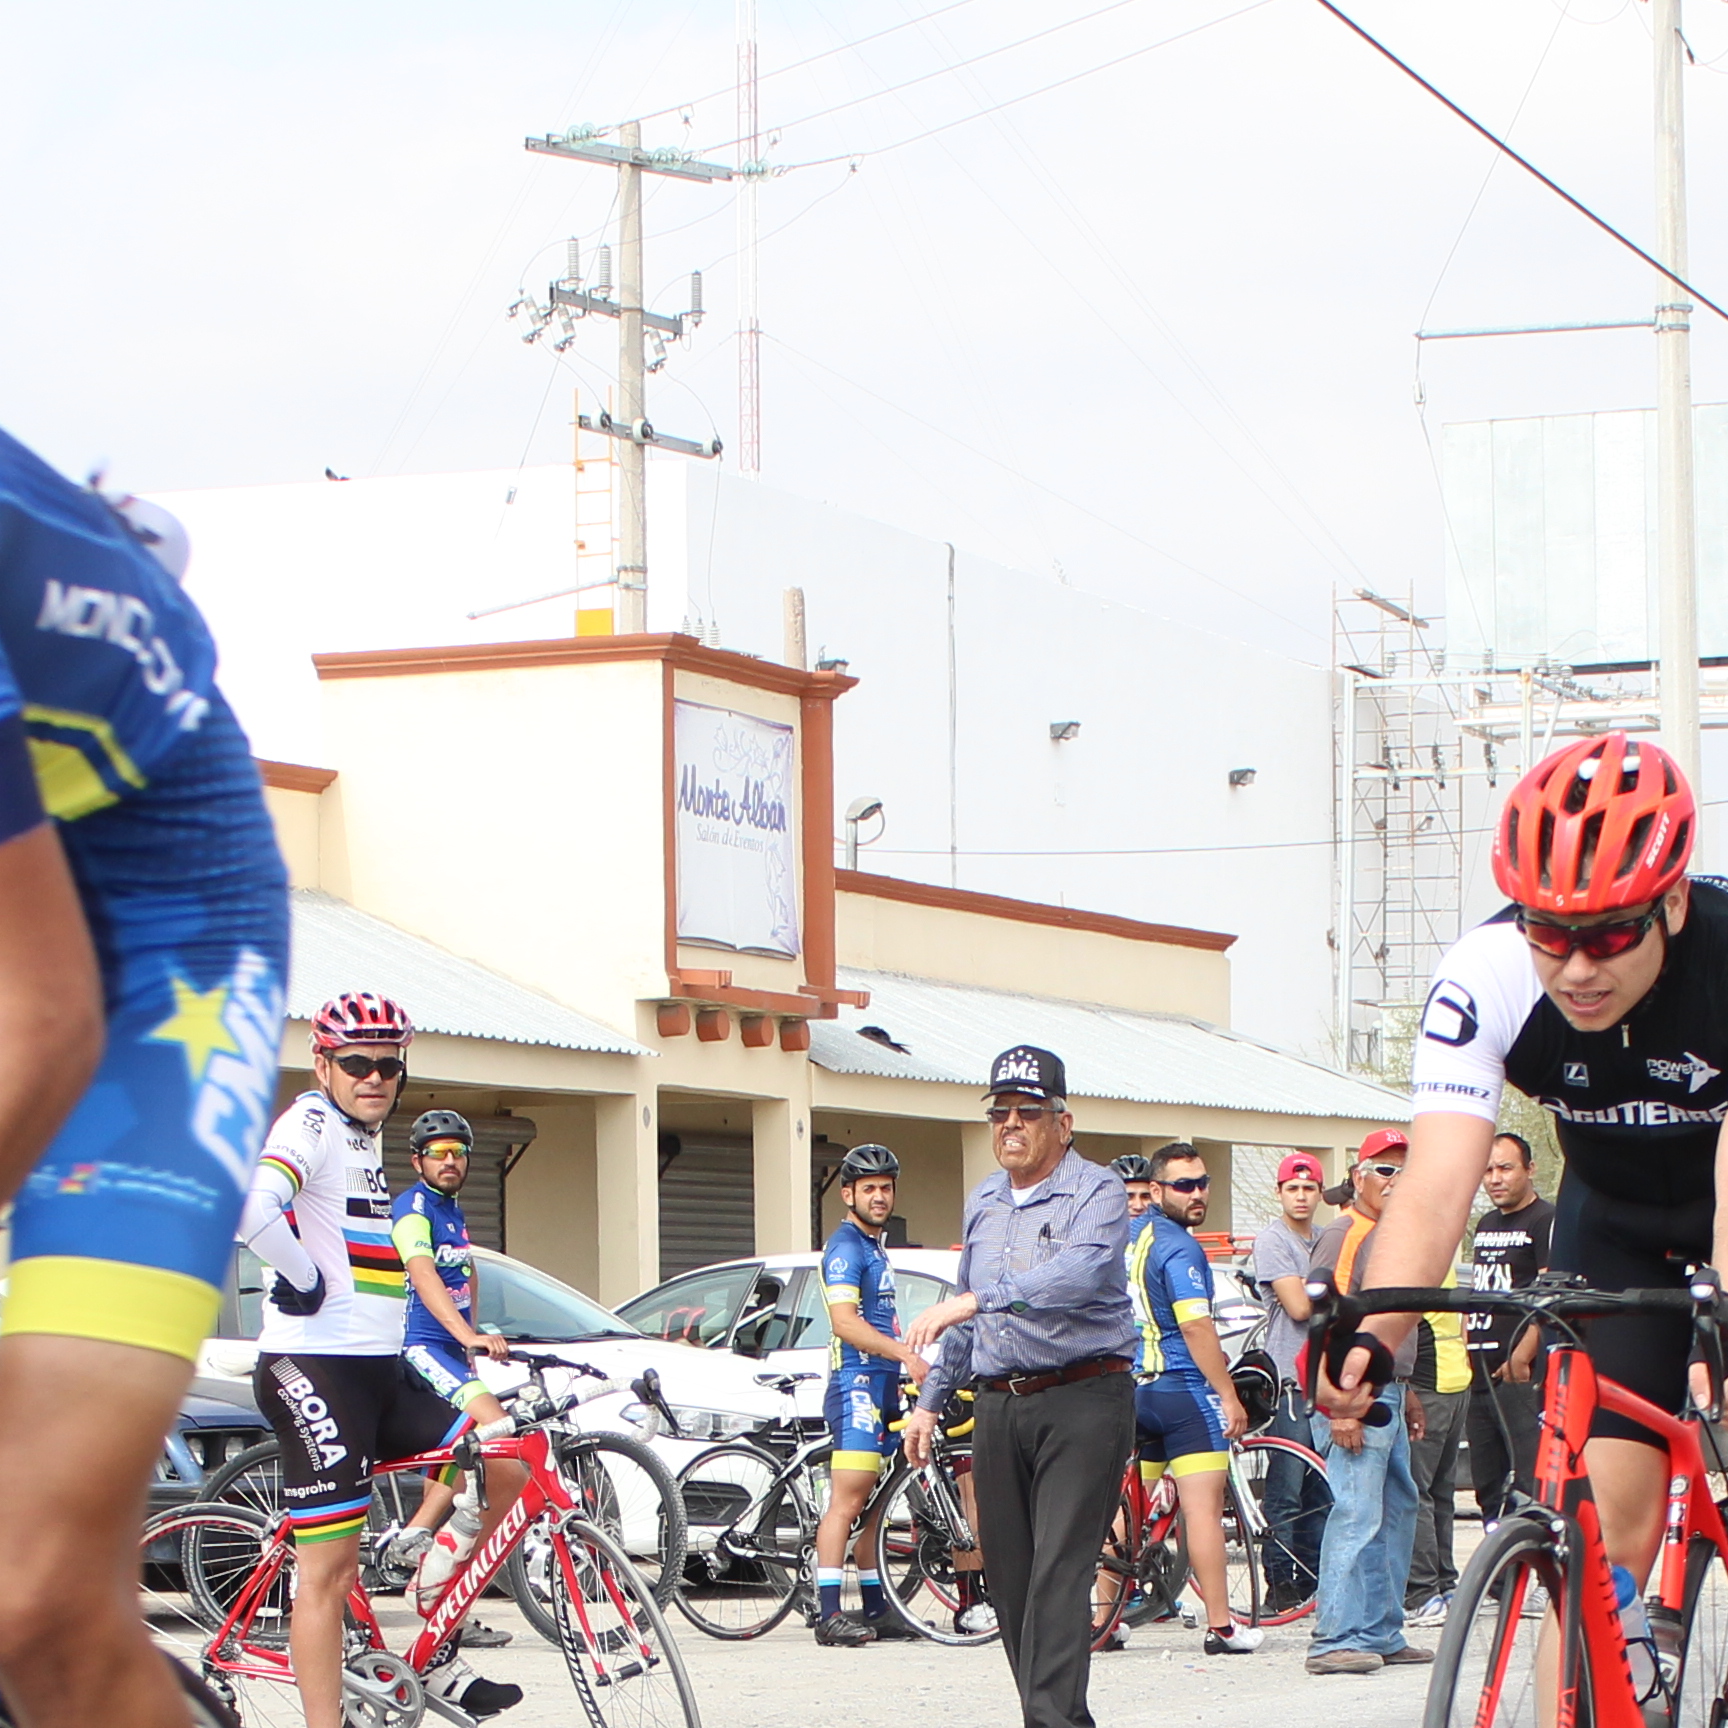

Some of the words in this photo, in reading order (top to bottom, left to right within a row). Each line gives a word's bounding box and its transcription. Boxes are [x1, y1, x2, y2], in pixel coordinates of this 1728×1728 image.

[677, 763, 730, 821] Monte
[734, 829, 764, 853] Eventos
[1645, 811, 1672, 870] SCOTT
[277, 1388, 304, 1430] cooking
[299, 1424, 324, 1473] systems
[286, 1375, 350, 1470] BORA
[426, 1496, 527, 1646] SPECIALIZED
